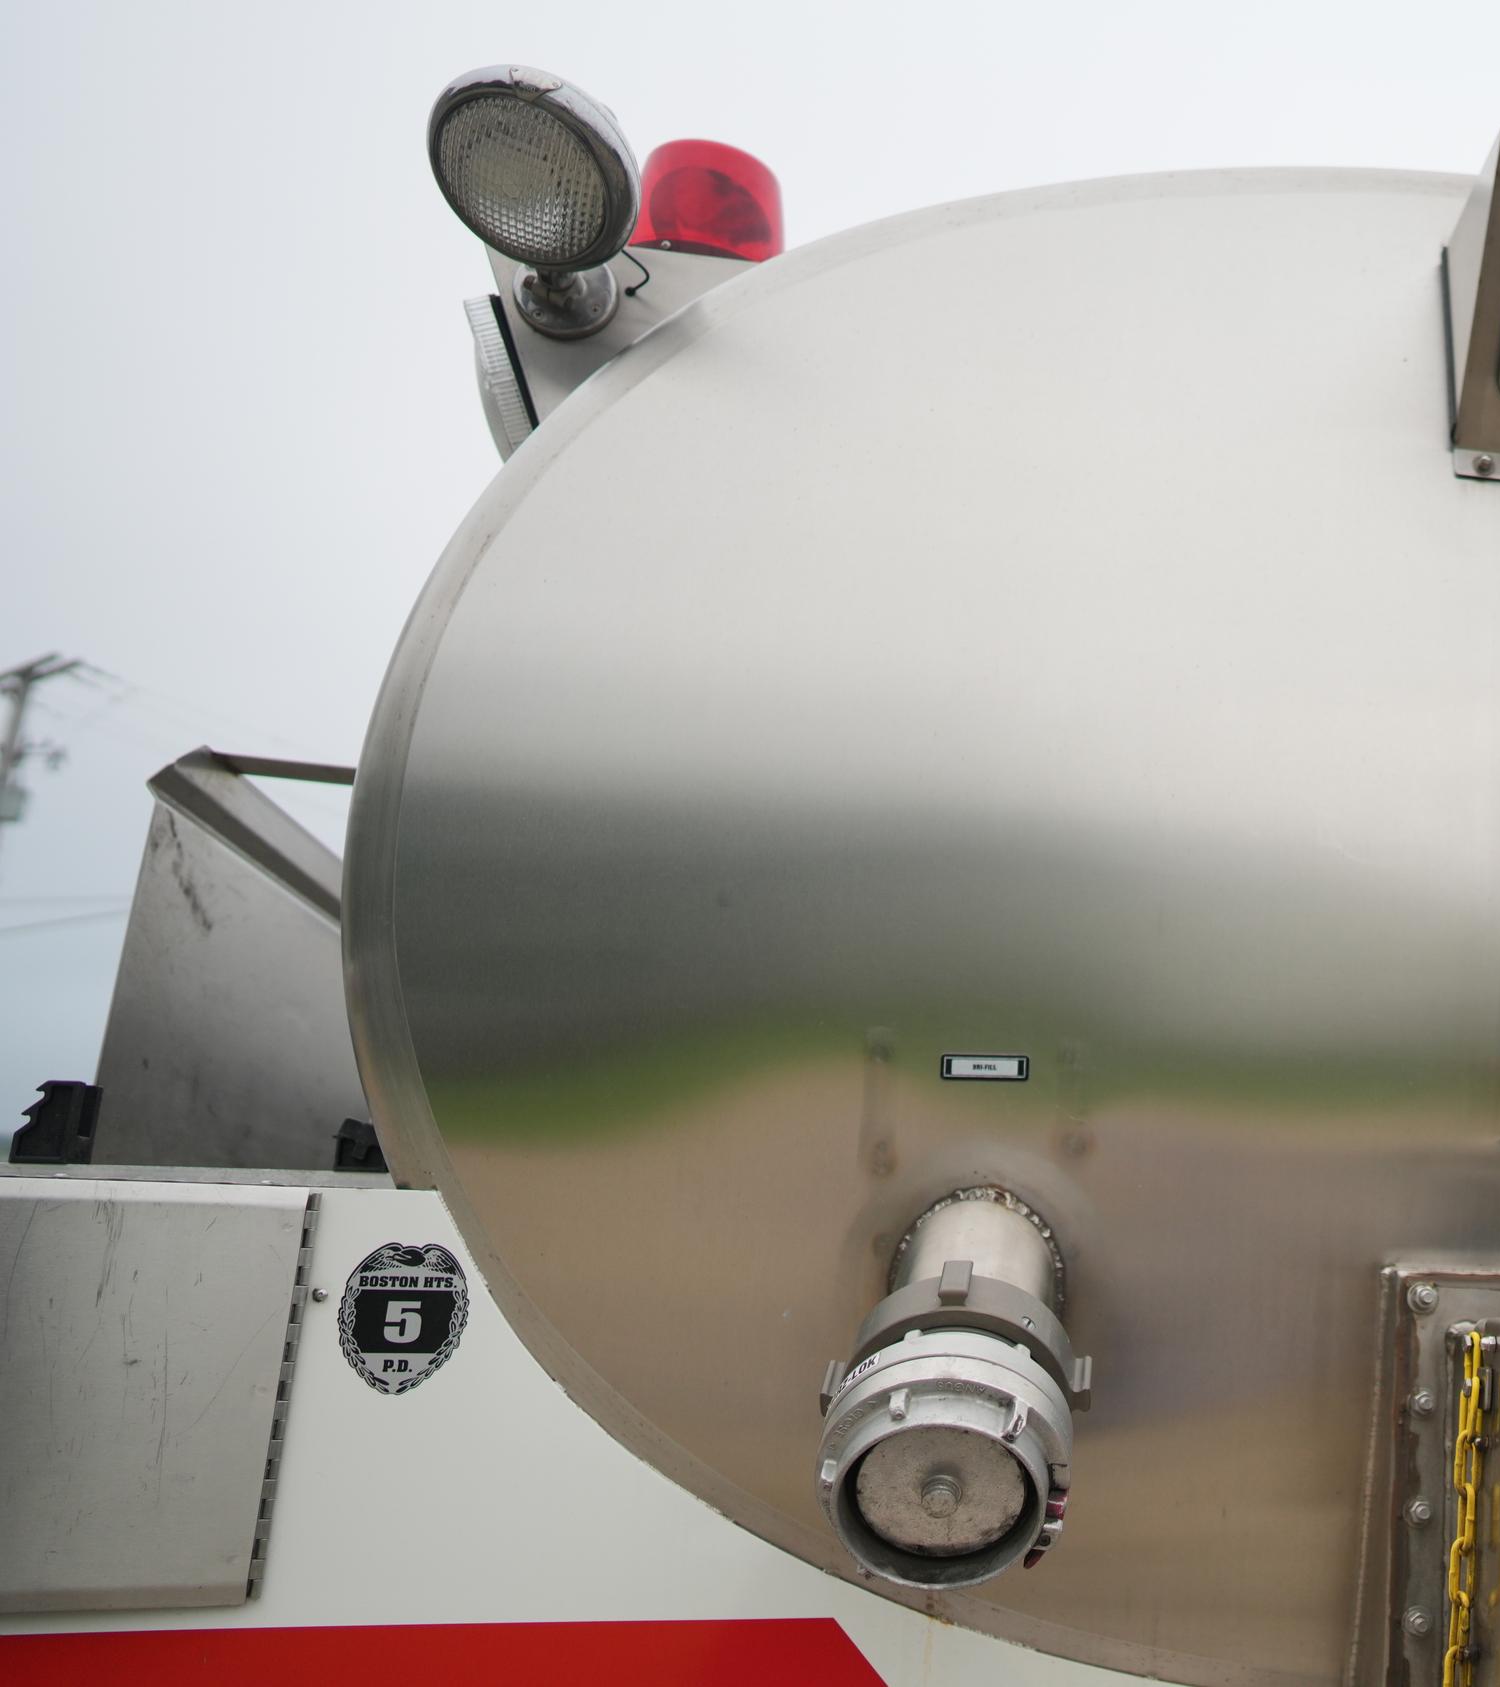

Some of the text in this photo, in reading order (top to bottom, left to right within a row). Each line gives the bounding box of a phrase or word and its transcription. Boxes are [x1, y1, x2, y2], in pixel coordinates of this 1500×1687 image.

[359, 1275, 457, 1289] BOSTON HTS.
[383, 1300, 422, 1344] 5
[382, 1359, 413, 1373] P.D.
